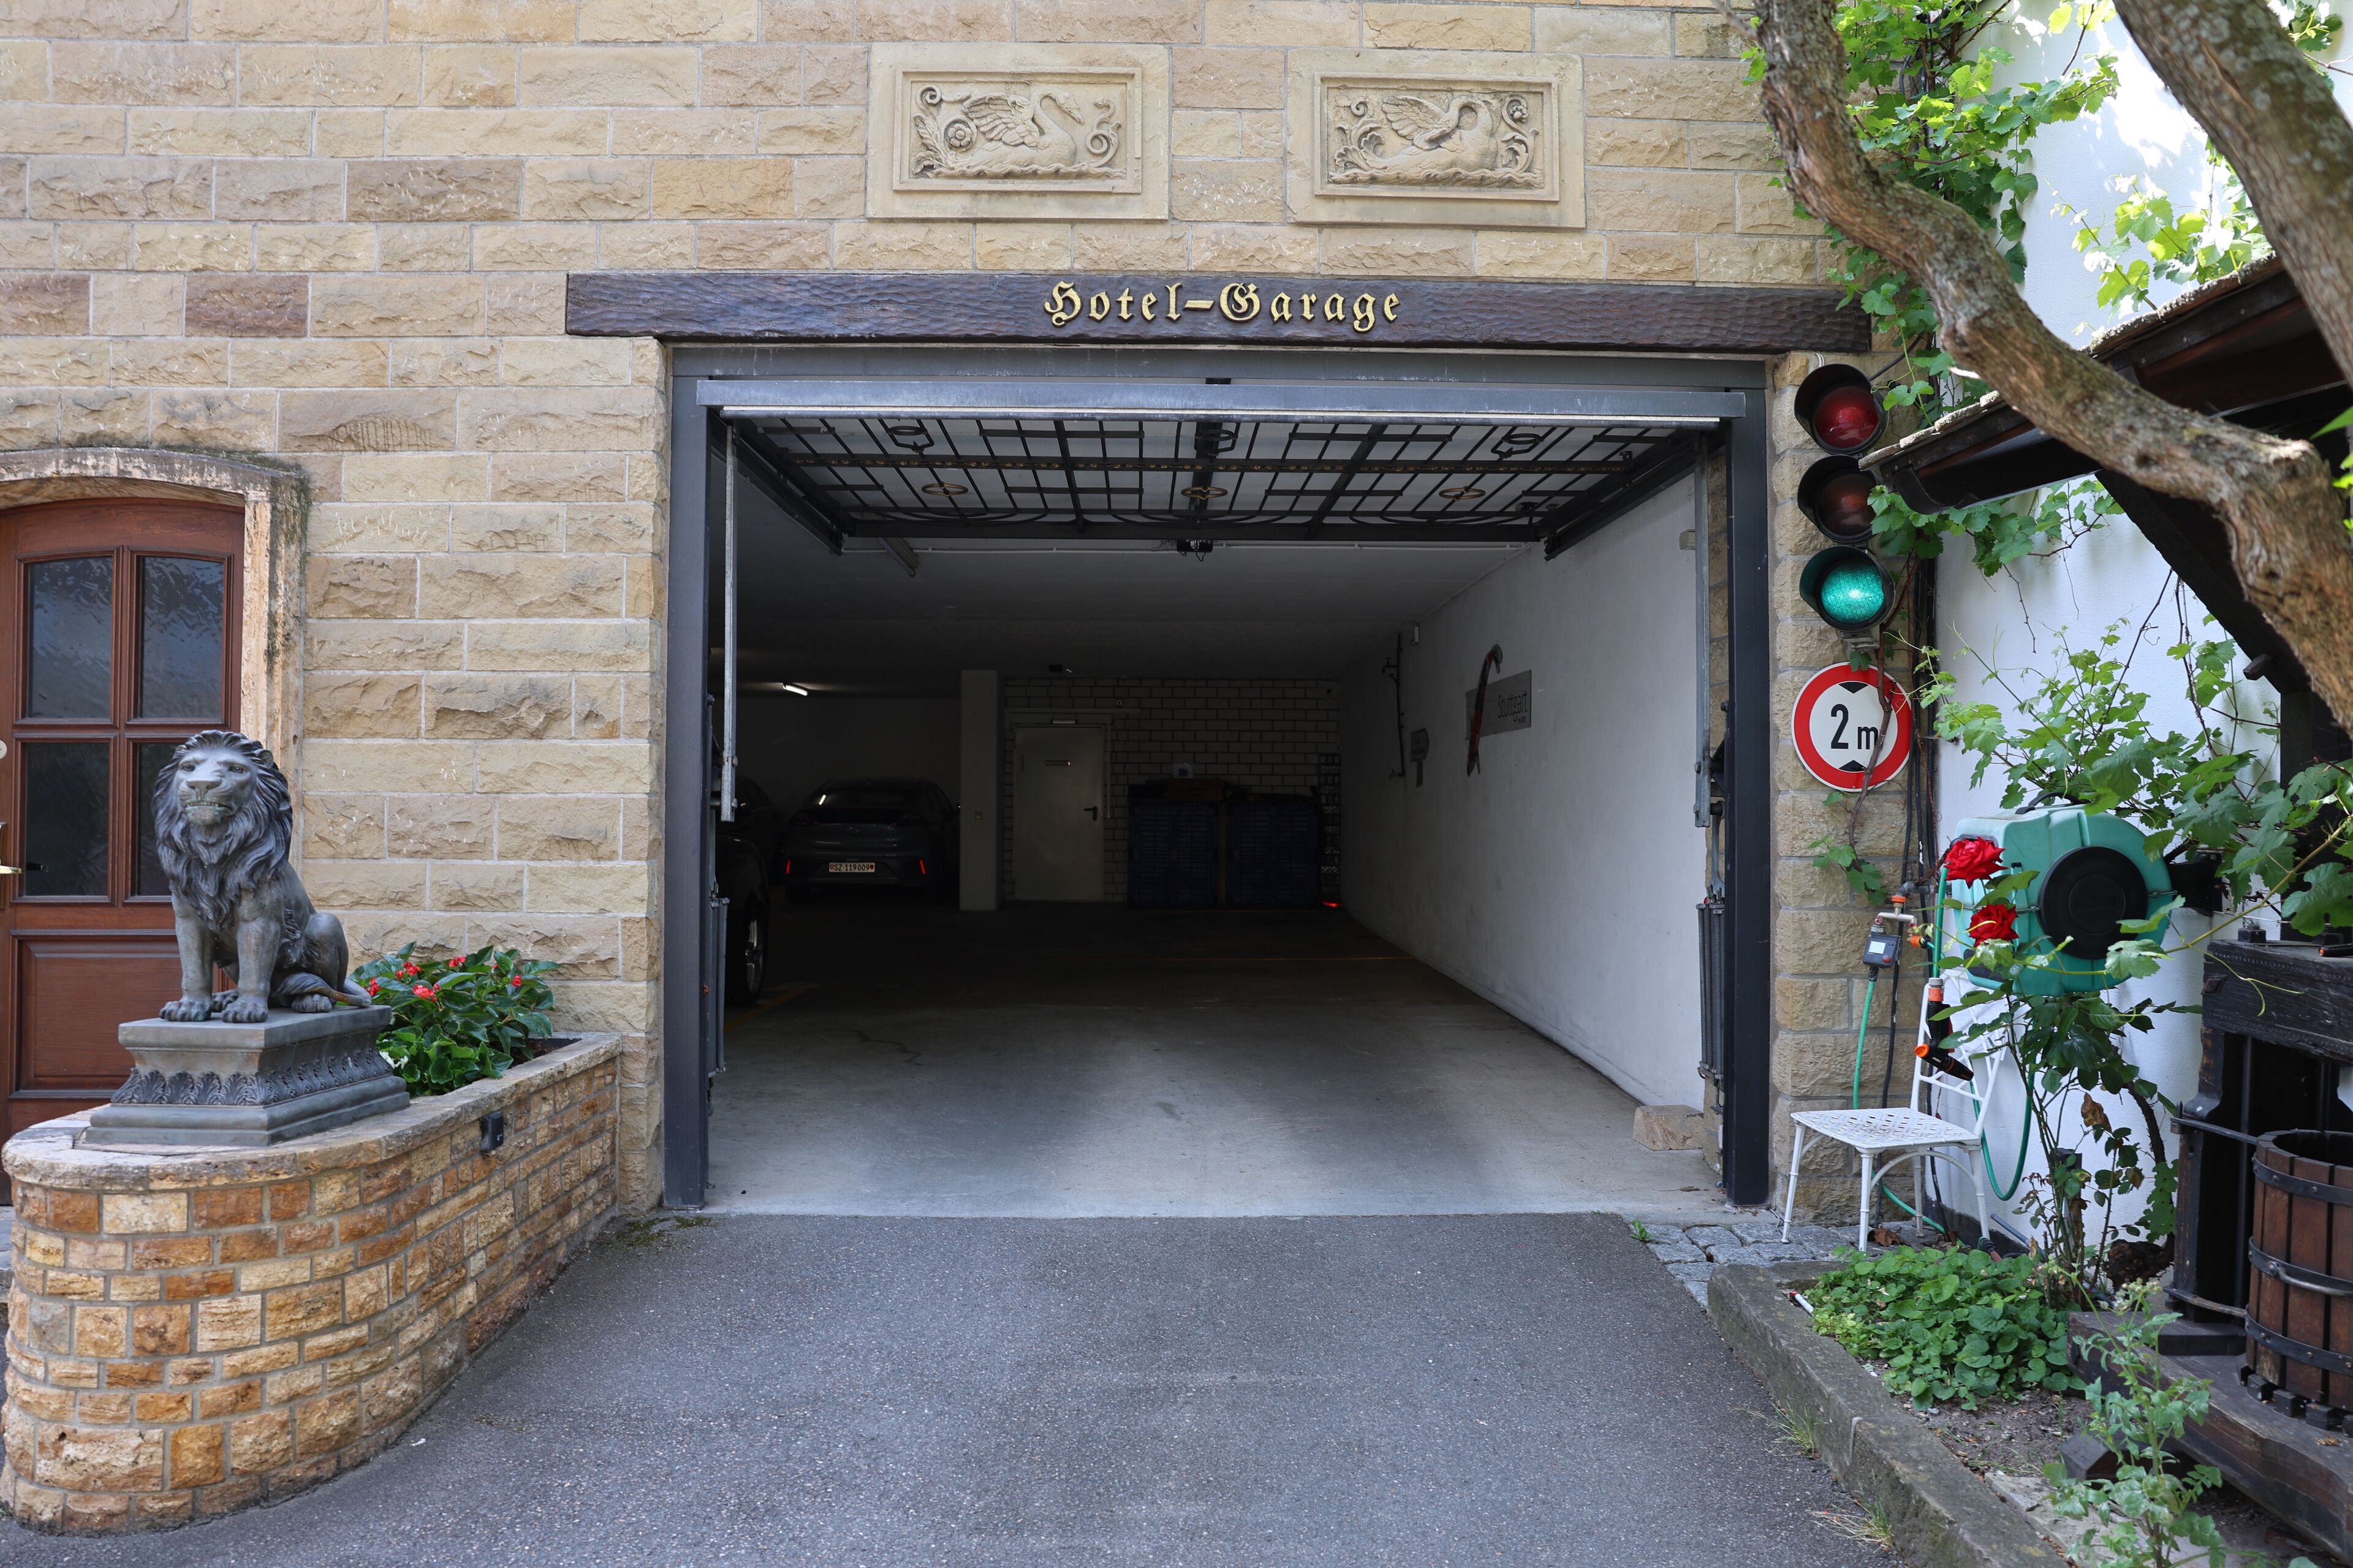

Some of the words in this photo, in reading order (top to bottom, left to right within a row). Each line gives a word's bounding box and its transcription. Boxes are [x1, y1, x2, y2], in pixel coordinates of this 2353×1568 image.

[1044, 280, 1401, 333] Hotel-Garage
[1498, 691, 1528, 722] Stuttgart
[1830, 703, 1849, 749] 2
[1857, 726, 1879, 749] m
